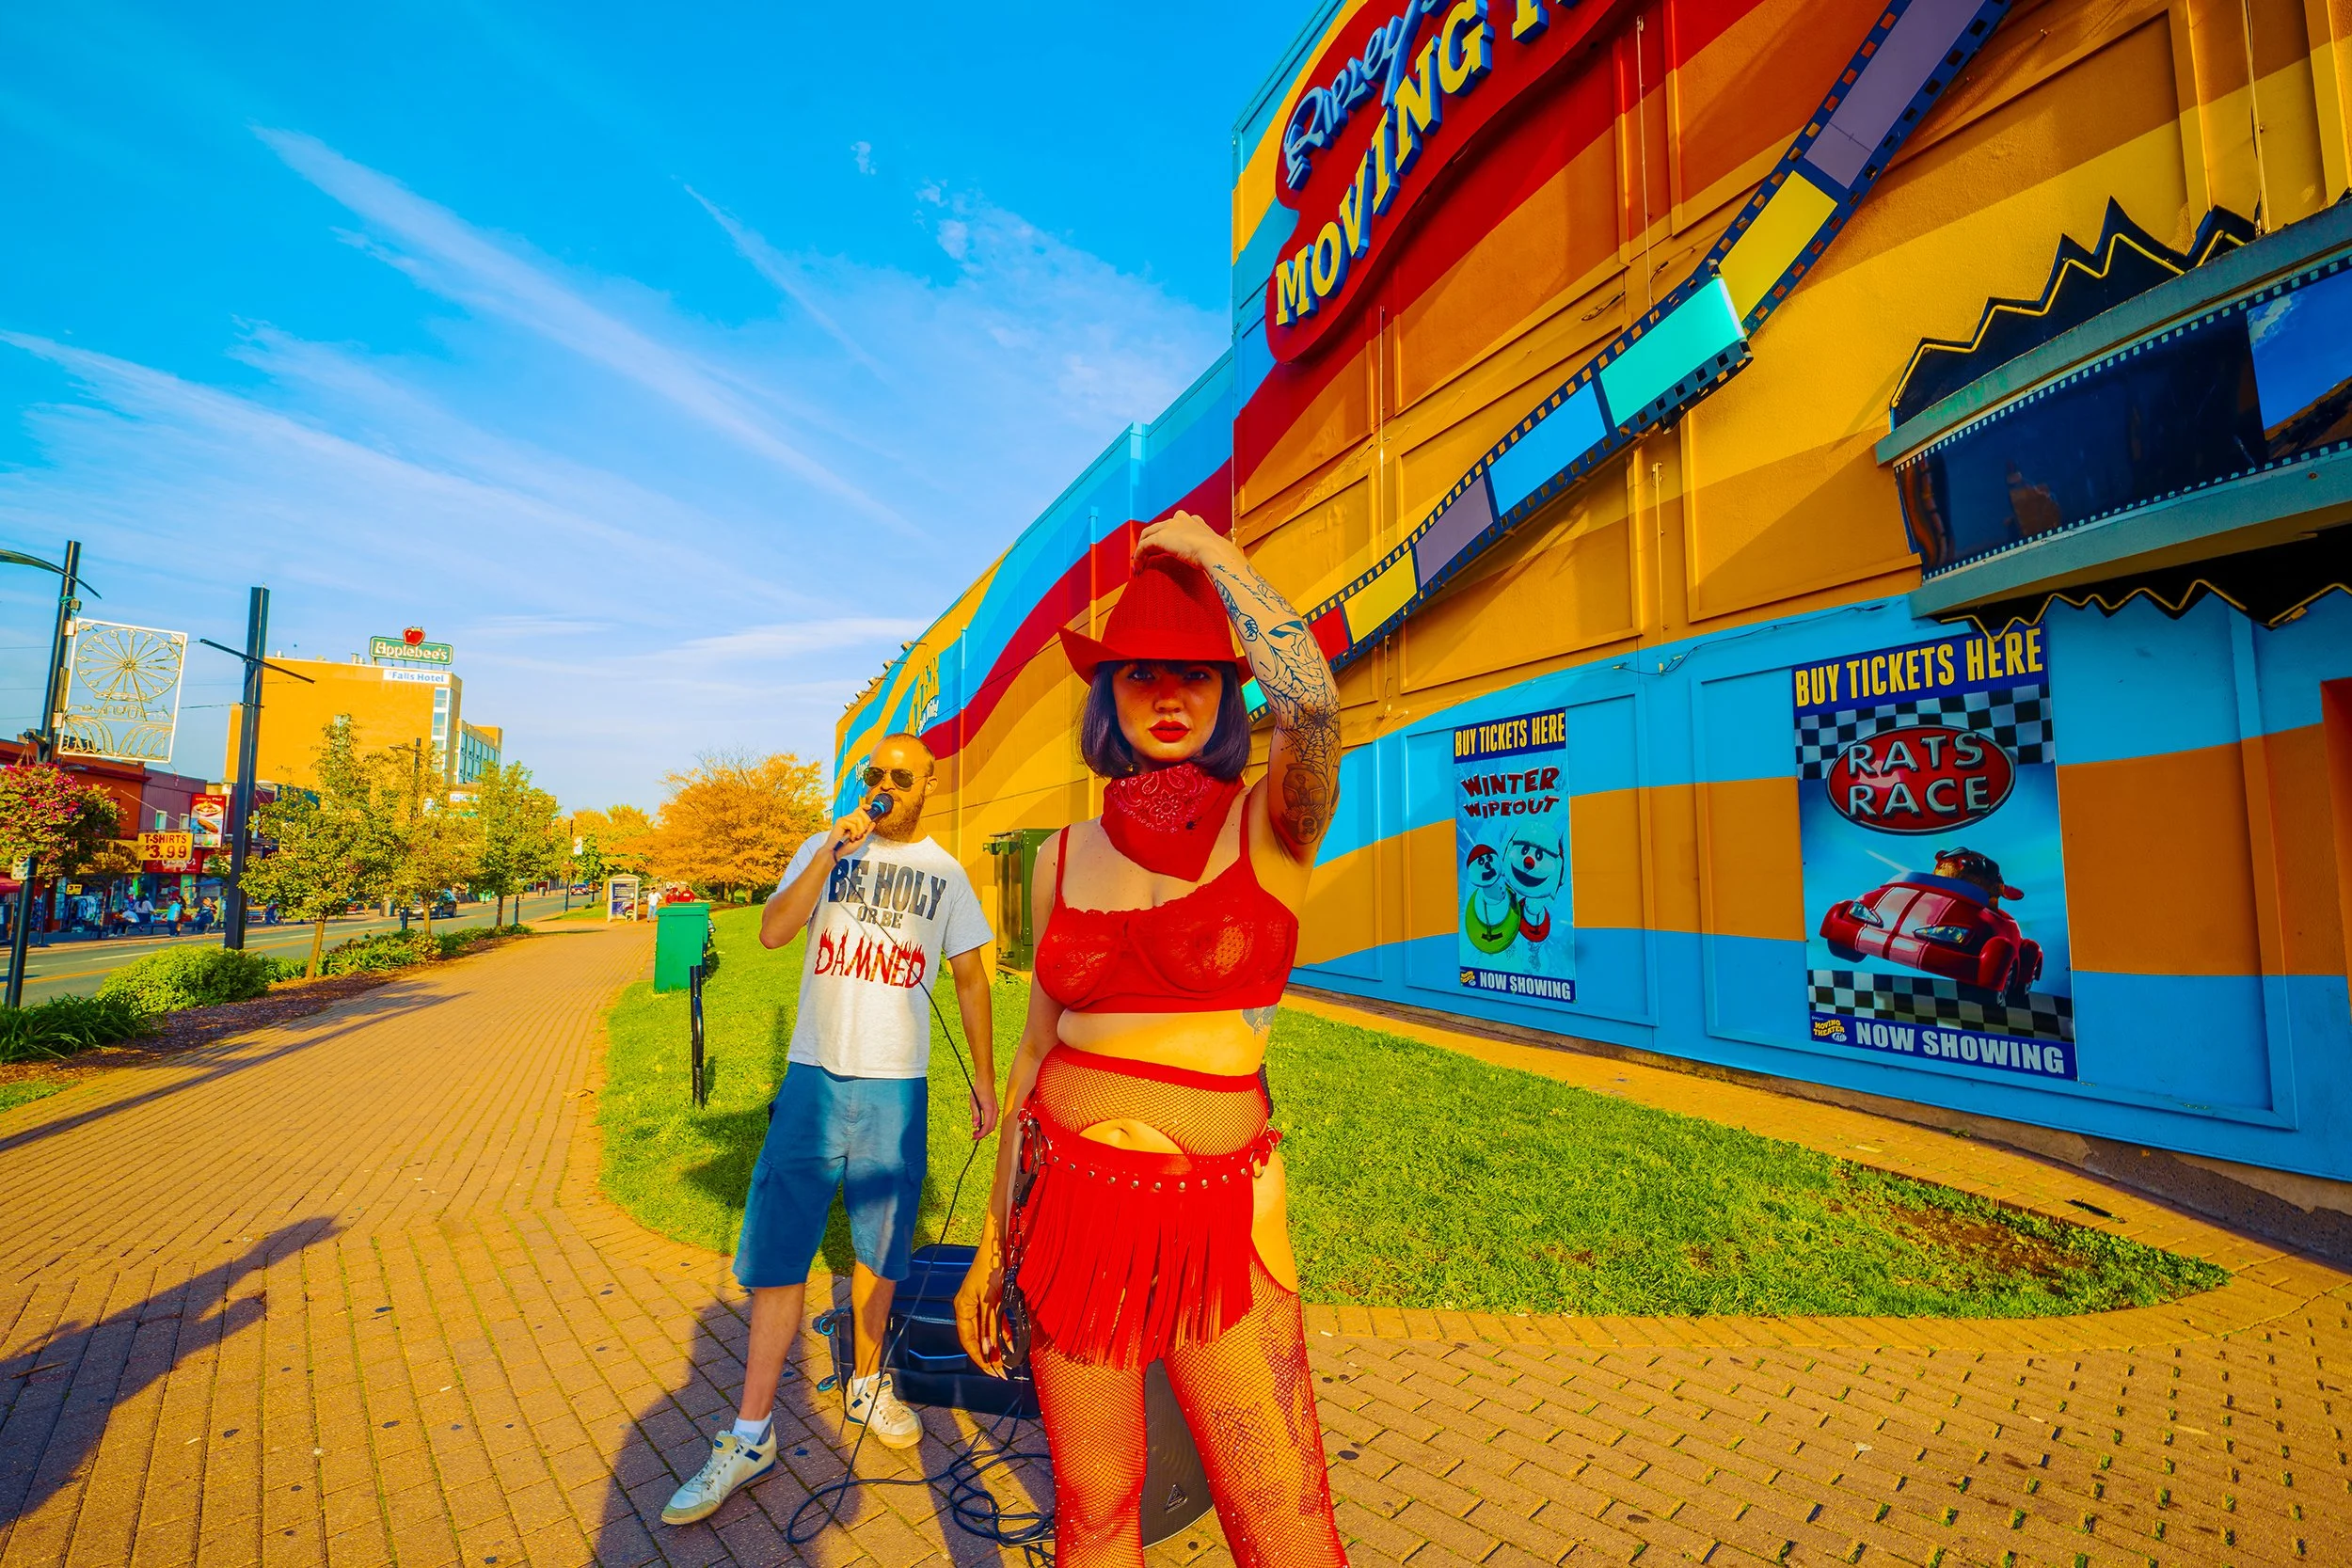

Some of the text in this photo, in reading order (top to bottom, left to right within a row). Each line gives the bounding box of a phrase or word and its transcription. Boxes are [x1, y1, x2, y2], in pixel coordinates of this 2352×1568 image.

[1276, 0, 1496, 327] MOVING
[374, 641, 448, 660] Applebee's
[1795, 627, 2043, 707] BUY TICKETS HERE
[391, 671, 444, 682] Falls Hotel
[1454, 712, 1565, 757] BUY TICKETS HERE
[1847, 732, 1984, 777] RATS
[1460, 766, 1561, 798] WINTER
[1847, 776, 1992, 818] RACE
[1463, 795, 1561, 819] WIPEOUT
[144, 833, 187, 844] T-SHIRTS
[145, 844, 187, 859] $3.99
[828, 858, 947, 921] BE HOLY
[857, 905, 904, 929] OR BE
[814, 926, 927, 989] DAMNED
[1480, 972, 1507, 990] NOW
[1509, 975, 1572, 1001] SHOWING
[1855, 1022, 2064, 1075] NOW SHOWING
